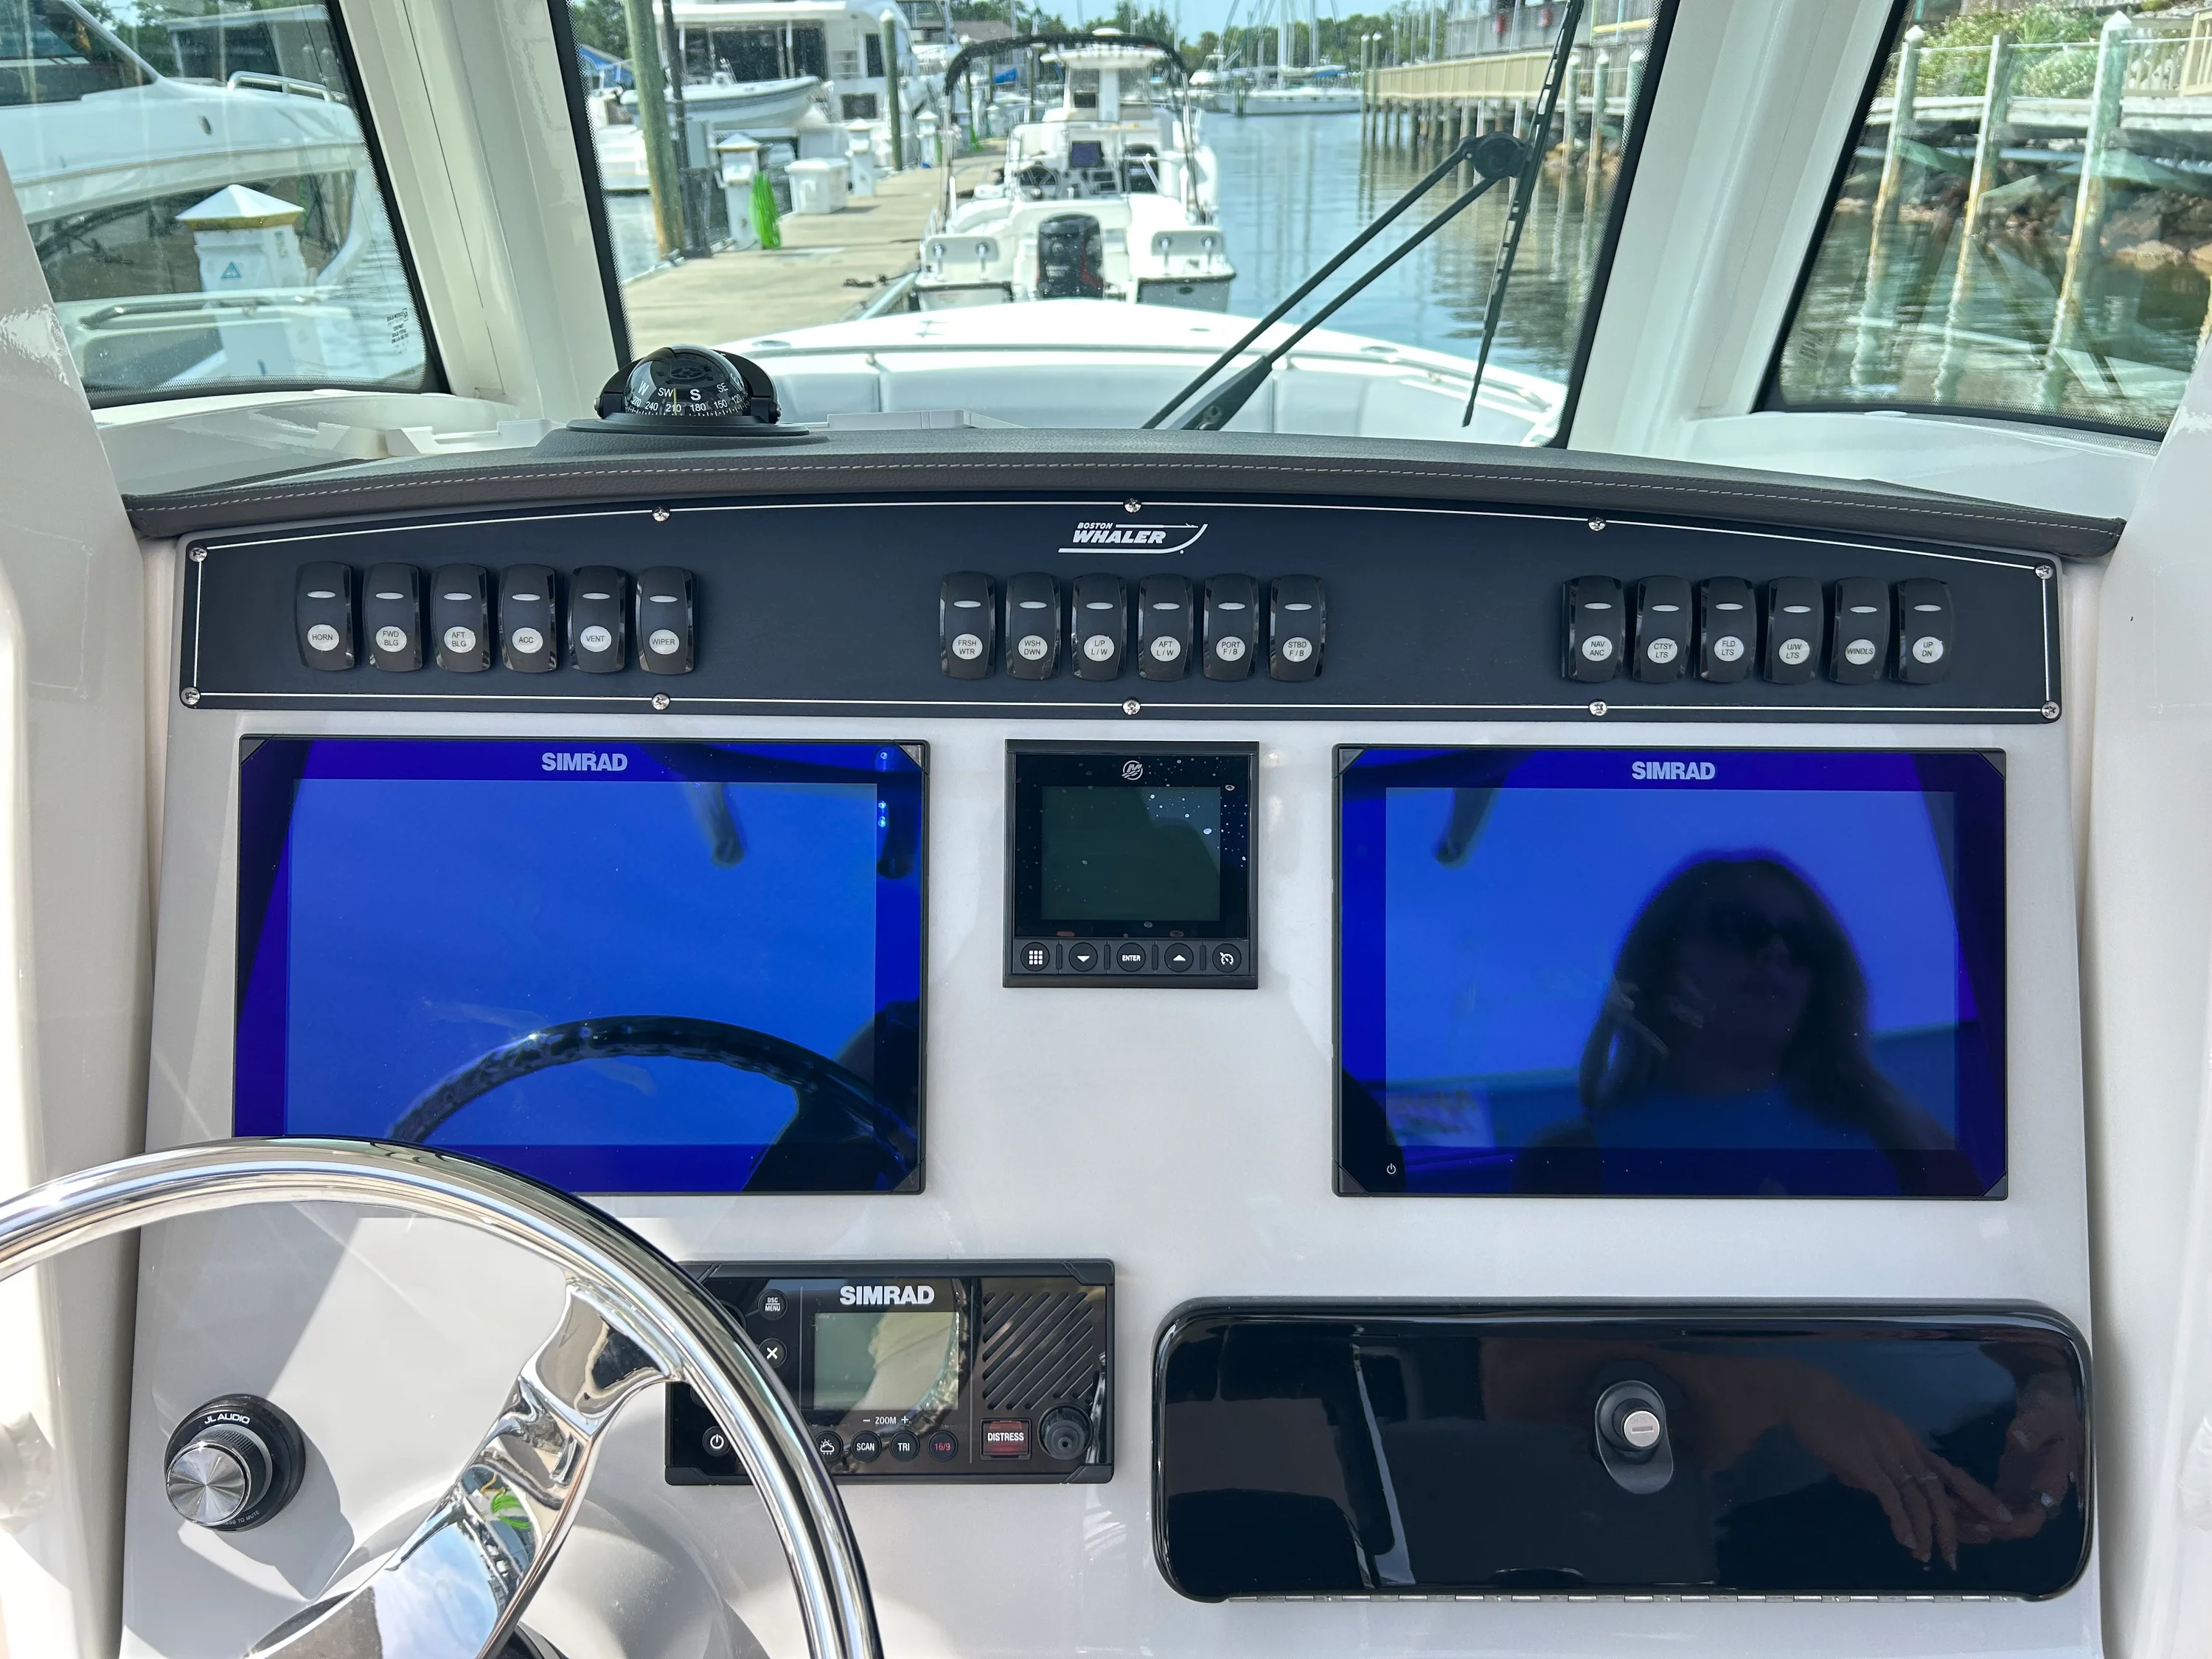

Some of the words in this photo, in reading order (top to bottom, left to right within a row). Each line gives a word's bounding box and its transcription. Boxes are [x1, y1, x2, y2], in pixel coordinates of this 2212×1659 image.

[638, 380, 650, 396] W
[658, 387, 673, 397] SW
[689, 389, 701, 400] S
[716, 382, 728, 393] SE
[644, 402, 658, 411] 240
[665, 403, 681, 412] 210
[690, 403, 706, 412] 180
[714, 399, 728, 409] 150
[1072, 530, 1166, 544] WHALER
[541, 752, 628, 771] SIMRAD
[1631, 761, 1716, 780] SIMRAD
[1121, 953, 1141, 961] ENTER
[840, 1285, 935, 1305] SIMRAD
[204, 1415, 216, 1425] JL
[217, 1413, 251, 1425] AUDIO
[874, 1416, 897, 1425] ZOOM
[987, 1432, 1024, 1441] DISTRESS
[856, 1442, 875, 1451] SCAN
[897, 1442, 910, 1451] TRI
[934, 1442, 950, 1451] 16/9
[246, 1510, 260, 1521] MUTE
